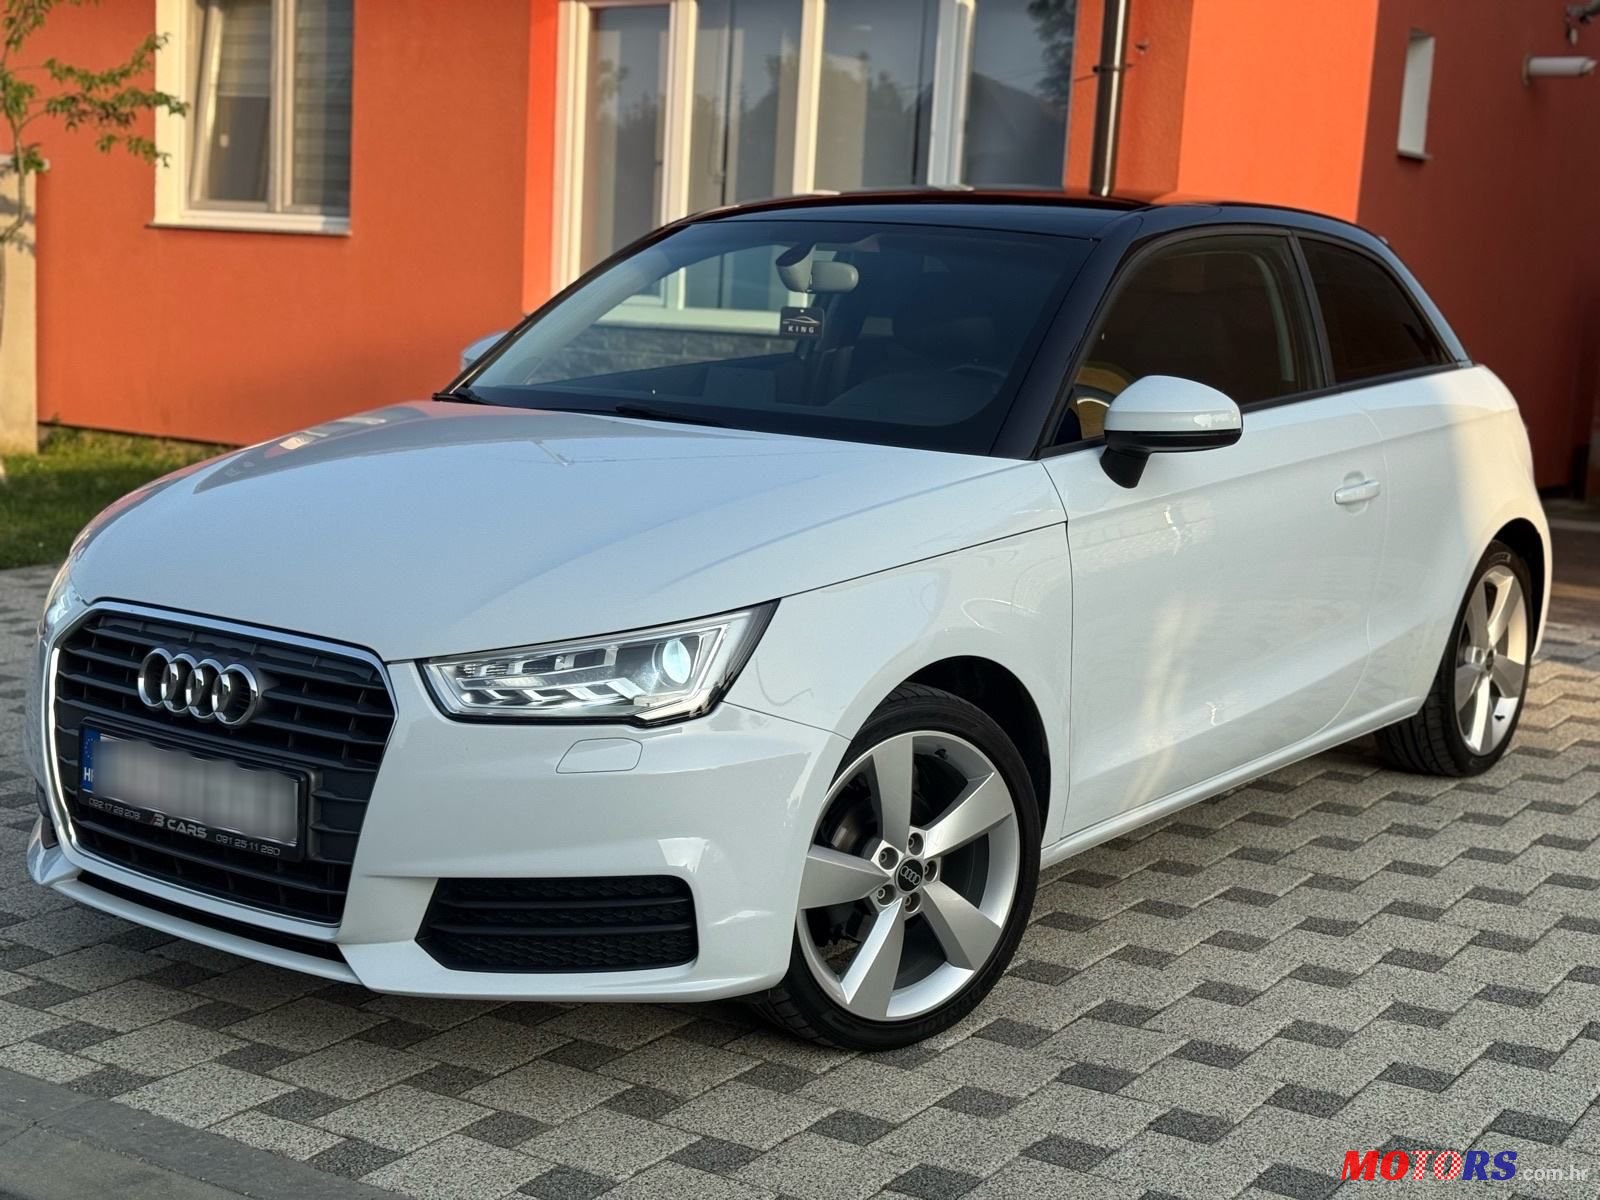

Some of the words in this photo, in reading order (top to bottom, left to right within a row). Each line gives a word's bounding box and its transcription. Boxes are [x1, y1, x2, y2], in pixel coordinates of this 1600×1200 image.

[788, 325, 815, 334] KING
[167, 819, 208, 839] CARS
[234, 838, 248, 849] 25
[249, 842, 259, 851] 11
